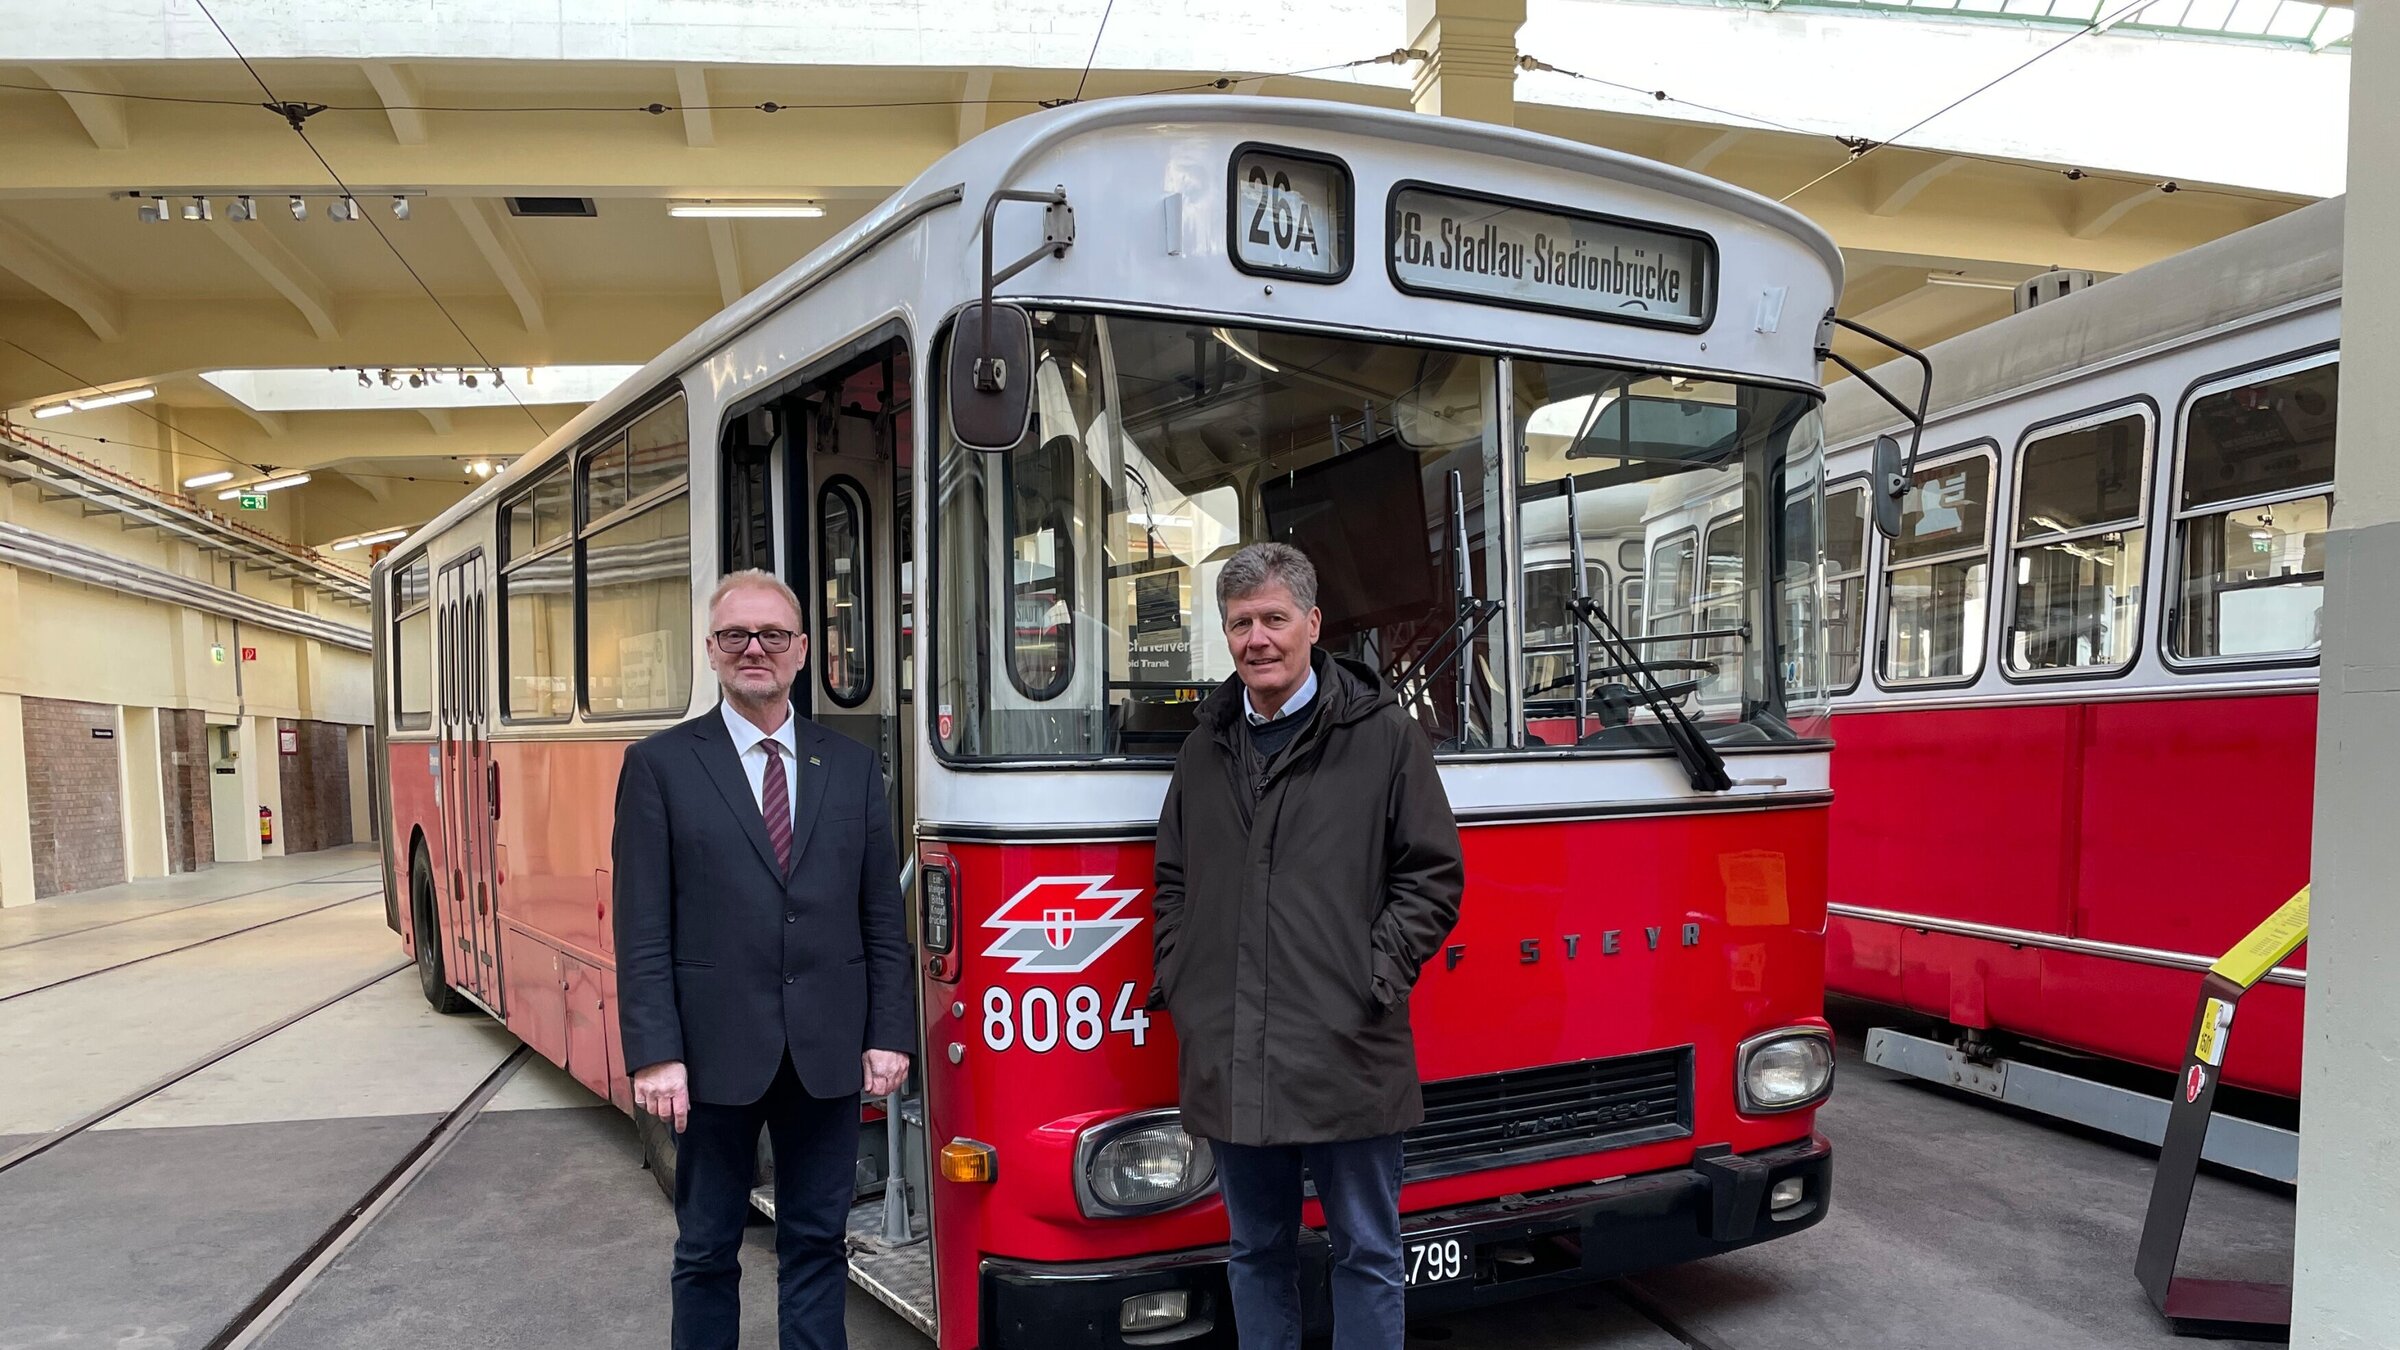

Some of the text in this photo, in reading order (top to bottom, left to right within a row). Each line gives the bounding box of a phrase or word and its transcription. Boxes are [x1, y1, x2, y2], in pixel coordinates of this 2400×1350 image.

[1248, 165, 1319, 256] 26A
[1520, 922, 1701, 964] STEYR
[982, 981, 1150, 1052] 8084
